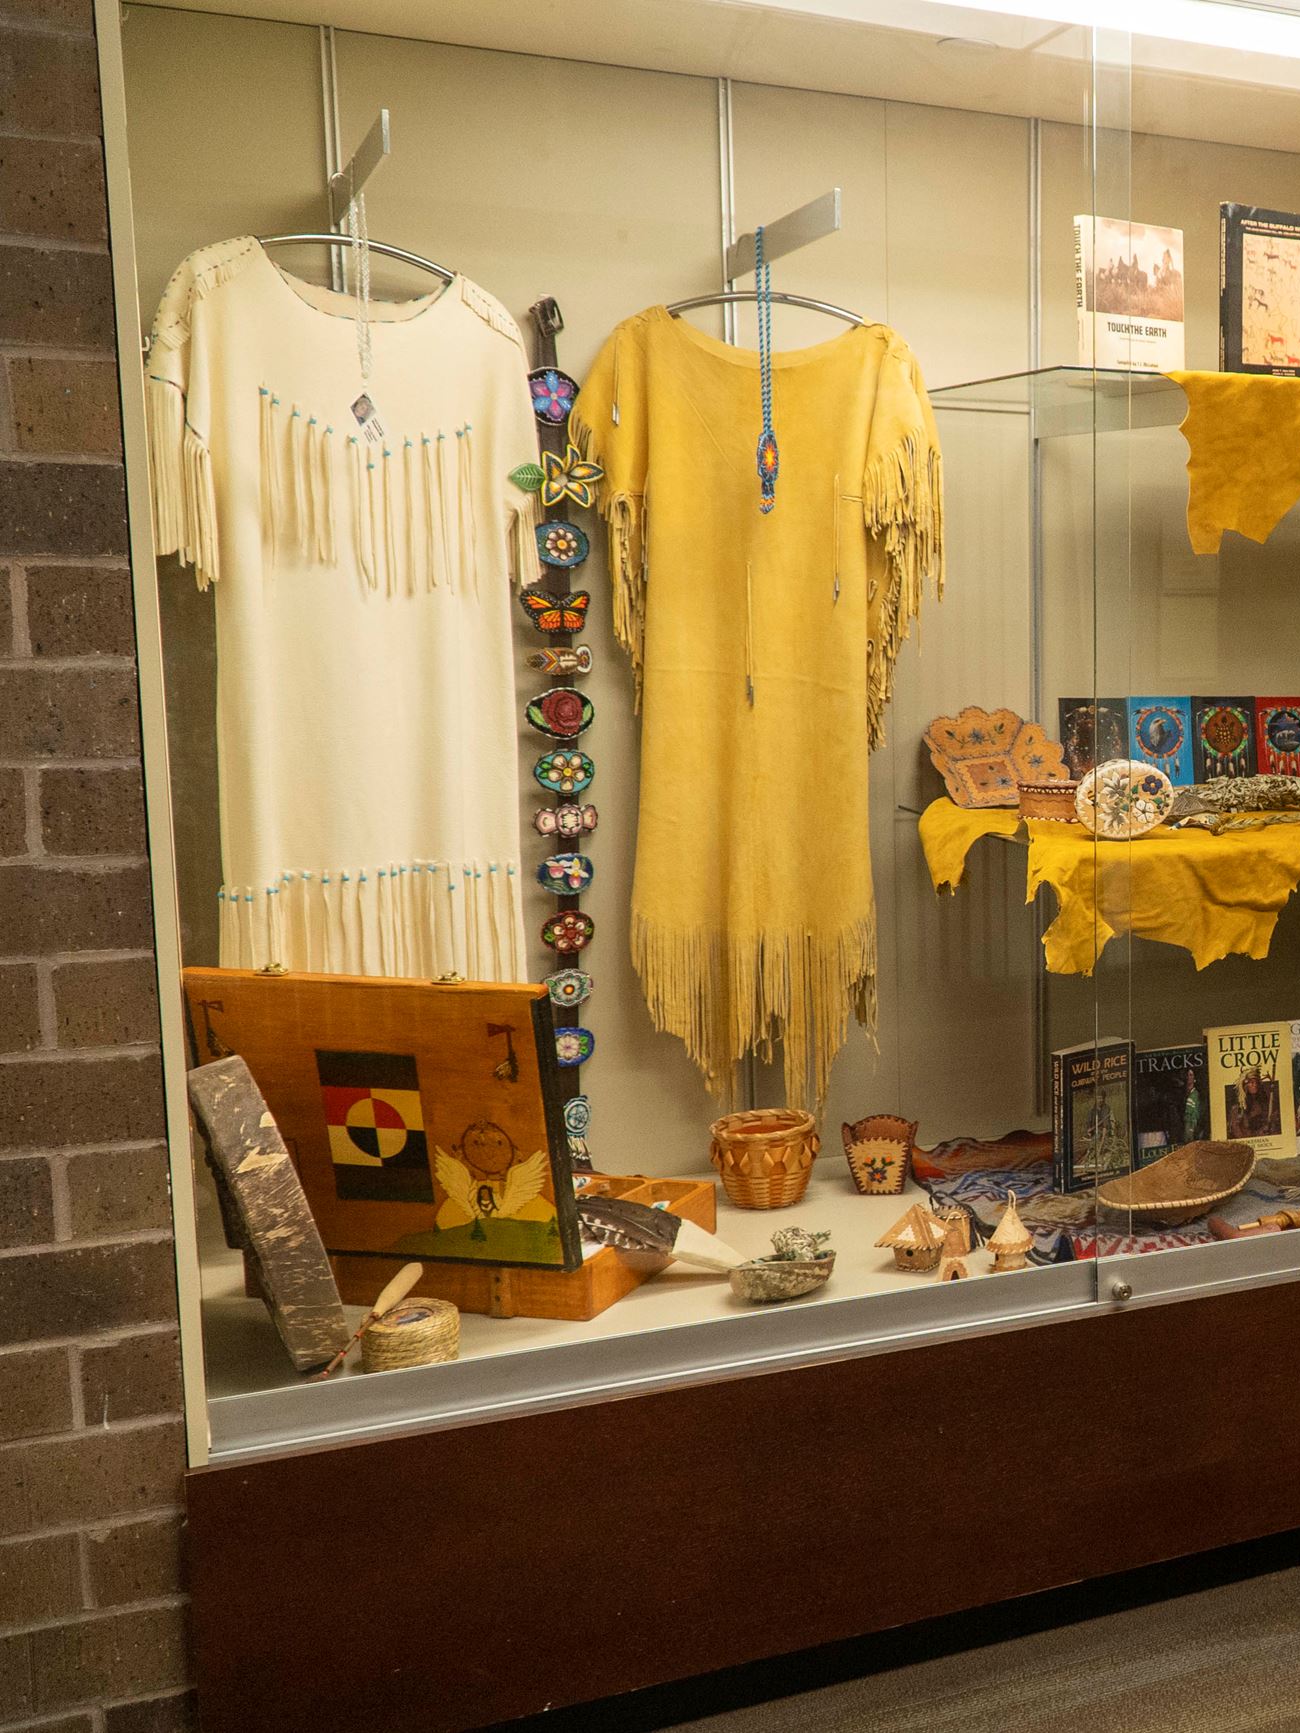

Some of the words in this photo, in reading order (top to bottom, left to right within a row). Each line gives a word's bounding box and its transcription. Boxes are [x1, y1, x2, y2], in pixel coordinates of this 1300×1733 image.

[1073, 224, 1082, 254] TOUCH
[1107, 322, 1129, 334] TOUCH
[1130, 324, 1143, 336] THE
[1145, 326, 1167, 338] EARTH
[1218, 1033, 1281, 1053] LITTLE
[1072, 1060, 1101, 1075] WILD
[1104, 1054, 1128, 1069] RICE
[1136, 1052, 1204, 1074] TRACKS
[1220, 1049, 1279, 1069] CROW
[1102, 1070, 1128, 1081] PEOPLE
